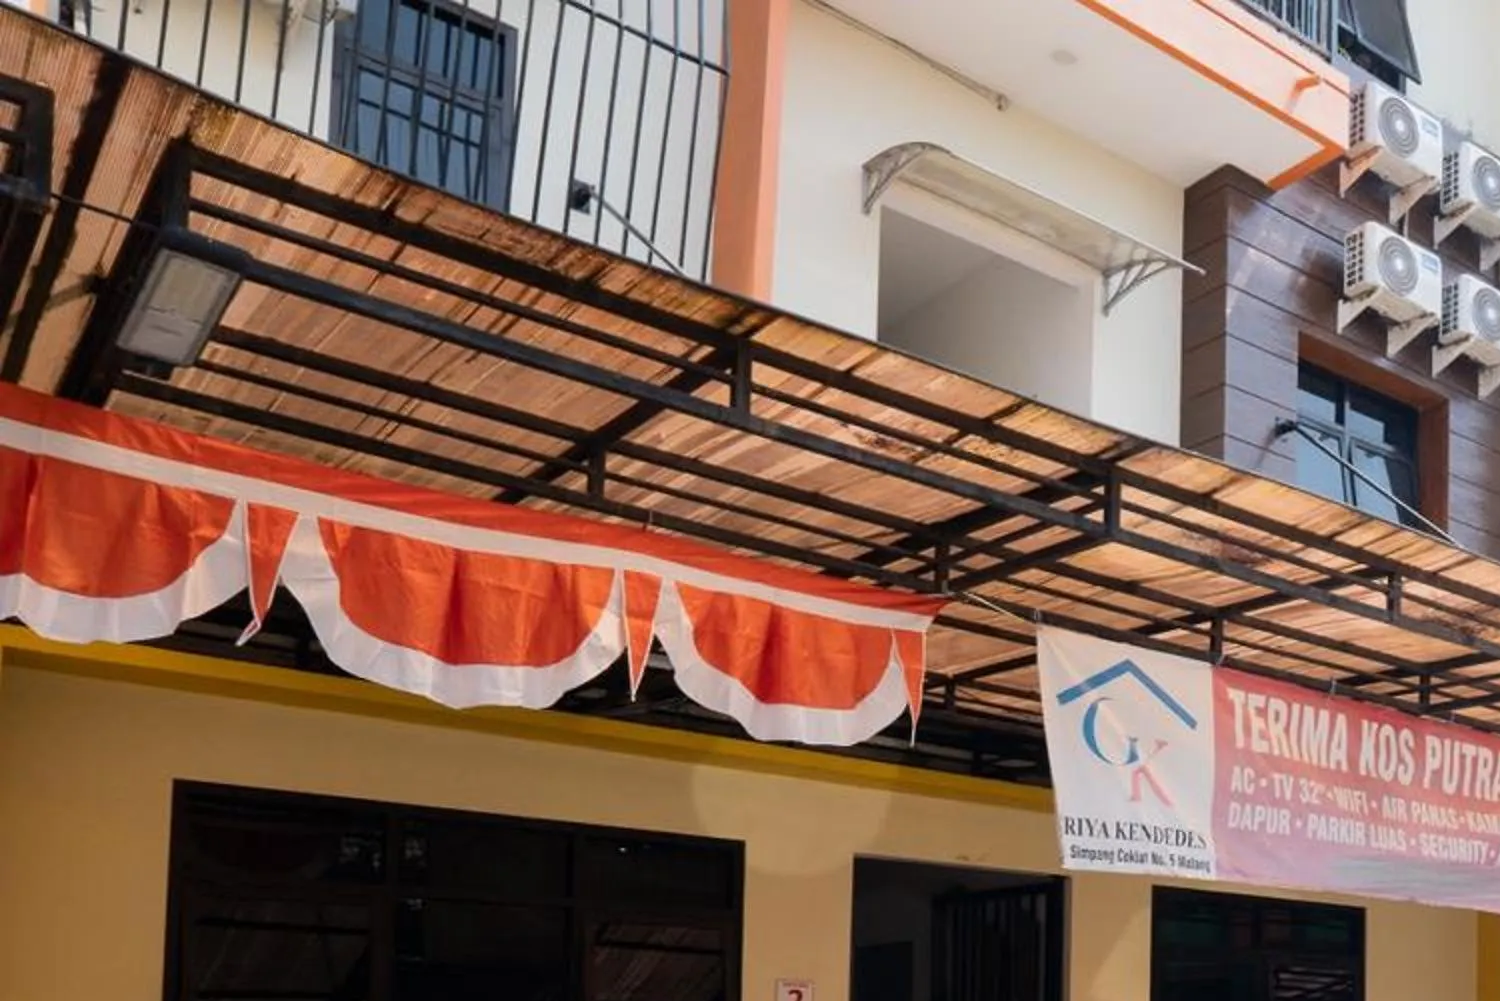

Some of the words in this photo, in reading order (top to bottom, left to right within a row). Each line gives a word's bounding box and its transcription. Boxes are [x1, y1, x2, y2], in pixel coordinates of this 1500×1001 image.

[1226, 687, 1348, 773] TERIMA
[1359, 719, 1416, 786] KOS
[1230, 765, 1256, 795] AC
[1272, 772, 1294, 800] TV
[1332, 785, 1369, 816] WIFI
[1381, 795, 1408, 823] AIR
[1411, 801, 1460, 830] PANAS
[1115, 820, 1208, 850] KENDEDES
[1227, 801, 1292, 836] DAPUR
[1307, 813, 1366, 846] PARKIR
[1370, 824, 1407, 851] LUAS
[1420, 833, 1490, 865] SECURITY
